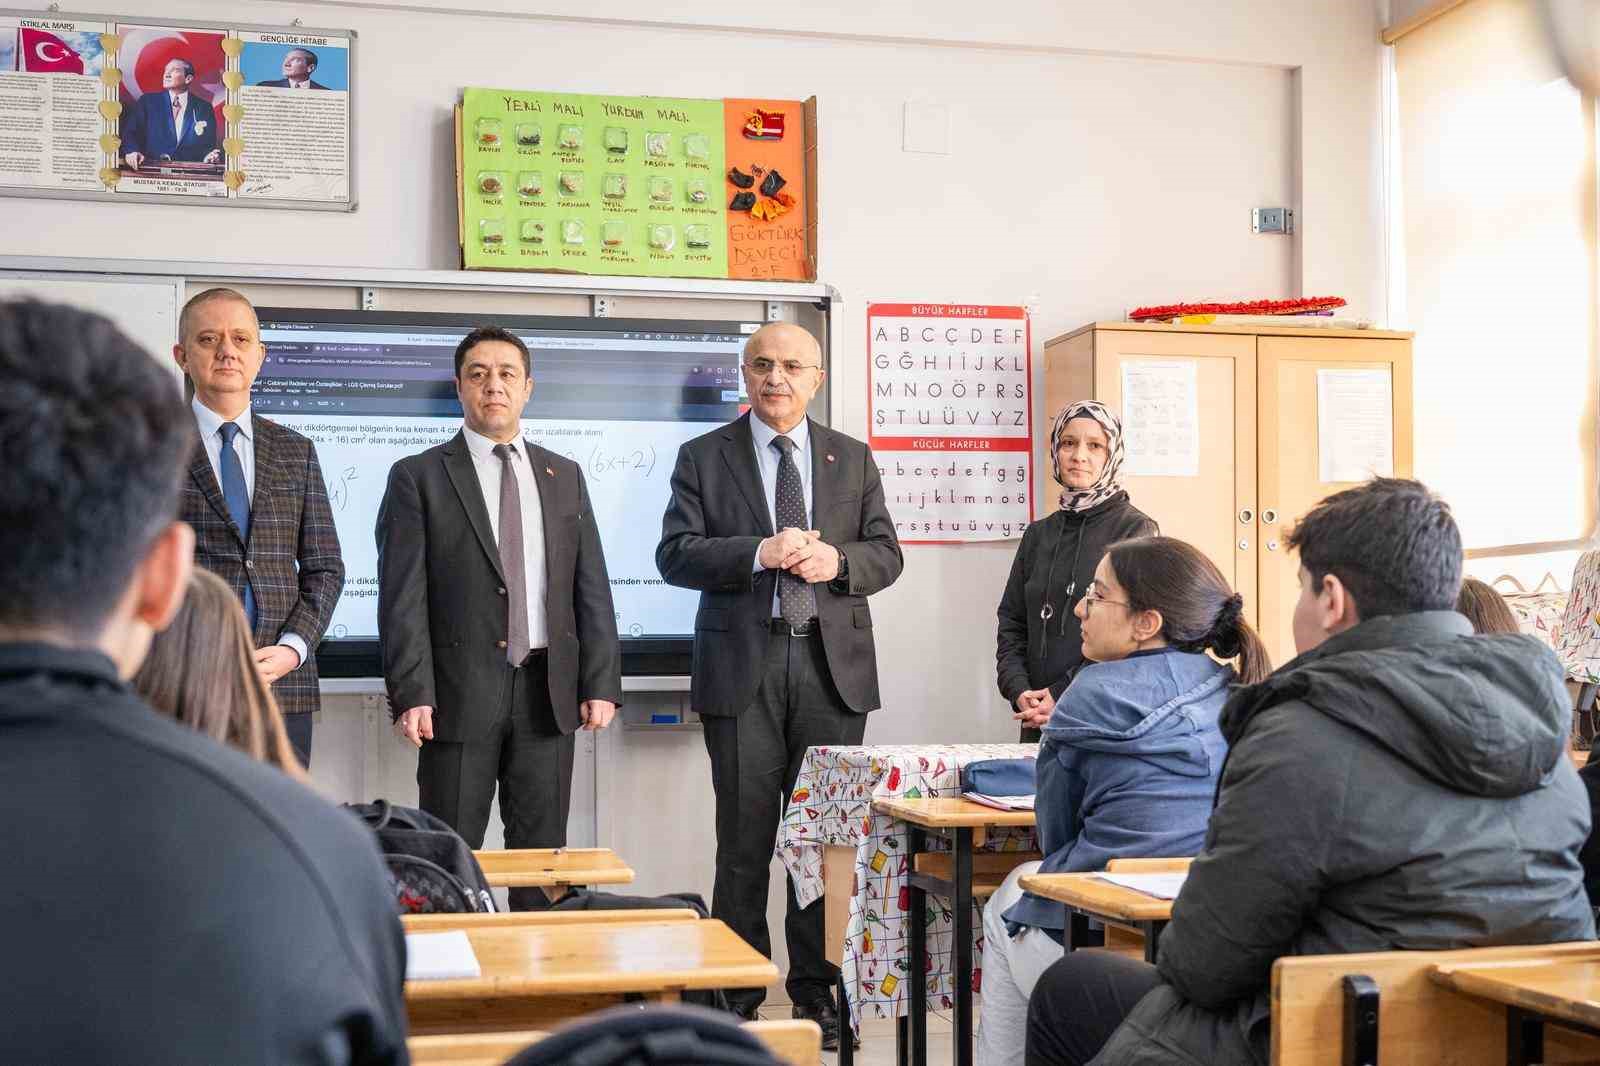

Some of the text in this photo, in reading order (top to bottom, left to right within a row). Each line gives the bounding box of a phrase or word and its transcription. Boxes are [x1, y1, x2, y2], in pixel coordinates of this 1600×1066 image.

[729, 224, 803, 242] GÖKTÜRK
[734, 244, 797, 266] DEVECİ
[912, 306, 988, 315] BÜYÜK HARFLER
[875, 327, 1023, 345] A B C Ç D E F
[875, 354, 889, 369] G
[899, 352, 913, 369] Ğ
[924, 356, 936, 370] H
[975, 356, 982, 371] J
[995, 356, 1005, 371] K
[1015, 356, 1024, 371] L
[877, 379, 1024, 398] M N O Ö P R S
[877, 406, 1024, 427] Ş T U Ü V Y Z
[913, 440, 990, 449] KÜÇÜK HARFLER
[897, 462, 904, 476] b
[915, 468, 922, 476] c
[931, 468, 938, 479] ç
[948, 462, 955, 476] d
[966, 468, 973, 476] e
[982, 462, 989, 476] f
[998, 469, 1005, 482] g
[1017, 466, 1024, 482] ğ
[919, 493, 925, 509] j
[935, 490, 941, 504] k
[965, 496, 975, 504] m
[985, 496, 992, 504] n
[1002, 496, 1009, 504] o
[1018, 493, 1025, 504] ö
[924, 523, 930, 533] ş
[938, 520, 944, 530] t
[969, 521, 976, 530] ü
[985, 523, 993, 531] v
[1003, 523, 1010, 536] y
